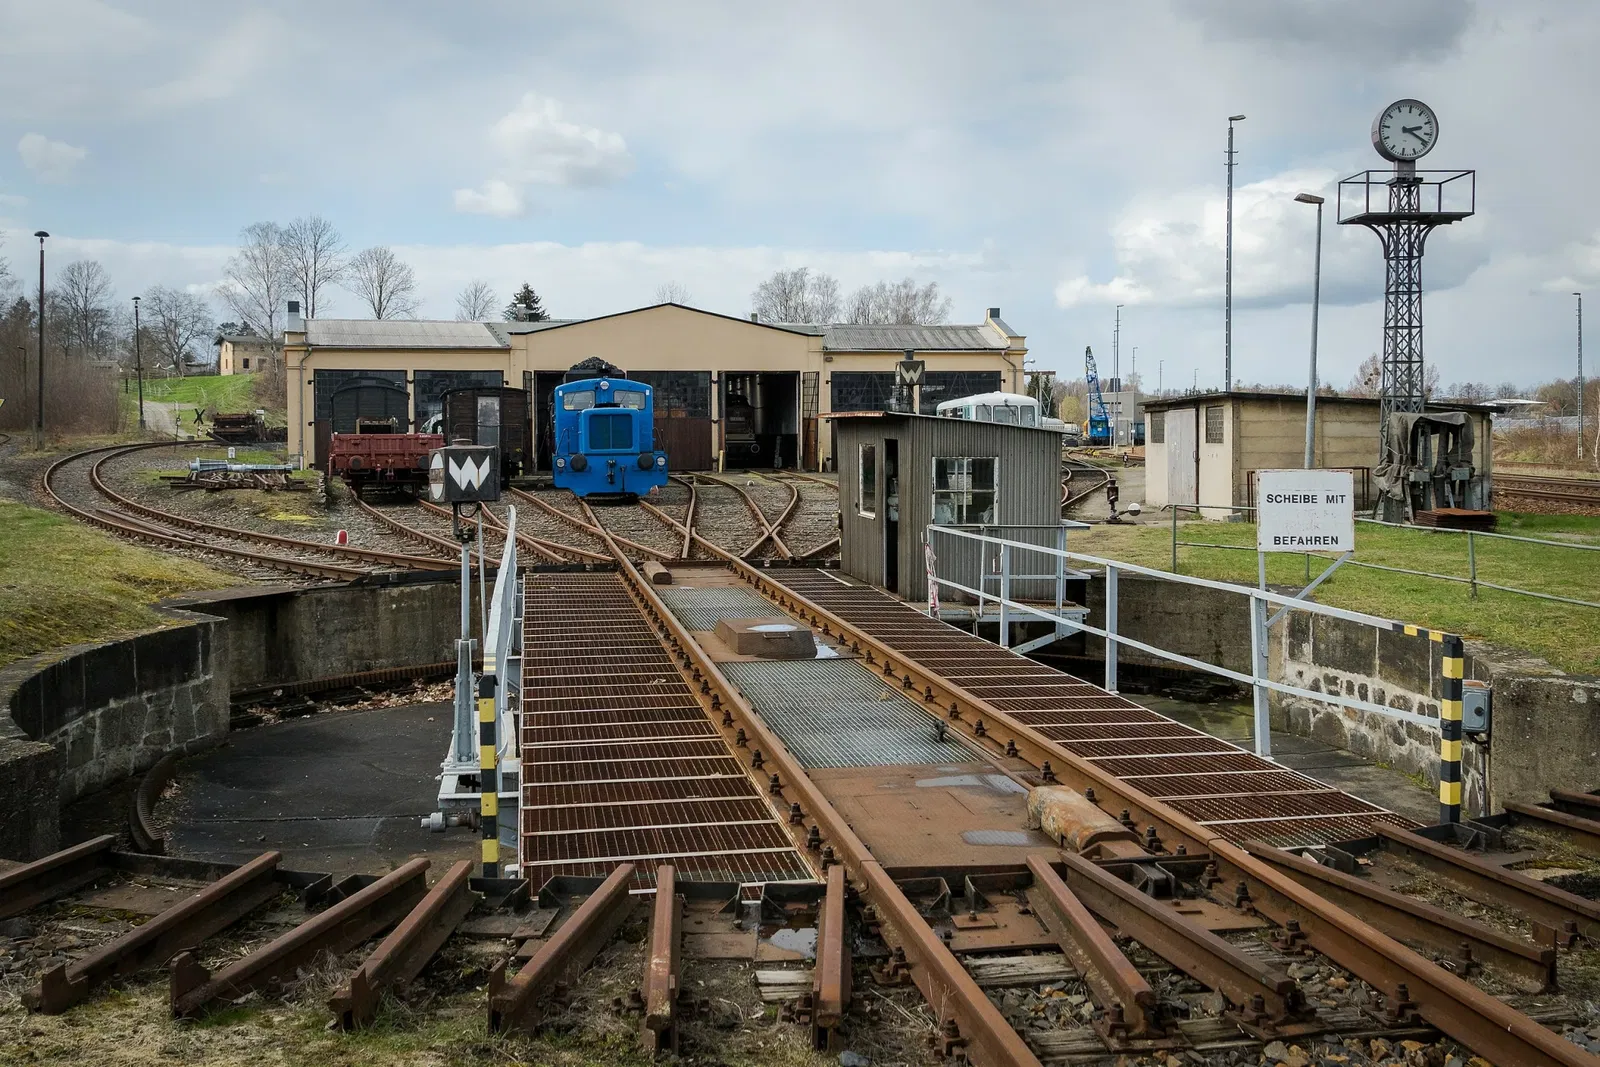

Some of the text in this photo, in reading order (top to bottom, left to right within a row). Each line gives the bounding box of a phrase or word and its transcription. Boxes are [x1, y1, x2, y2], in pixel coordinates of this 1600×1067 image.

[901, 364, 922, 383] W
[1266, 494, 1346, 504] SCHEIBE MIT
[1273, 536, 1339, 546] BEFAHREN
